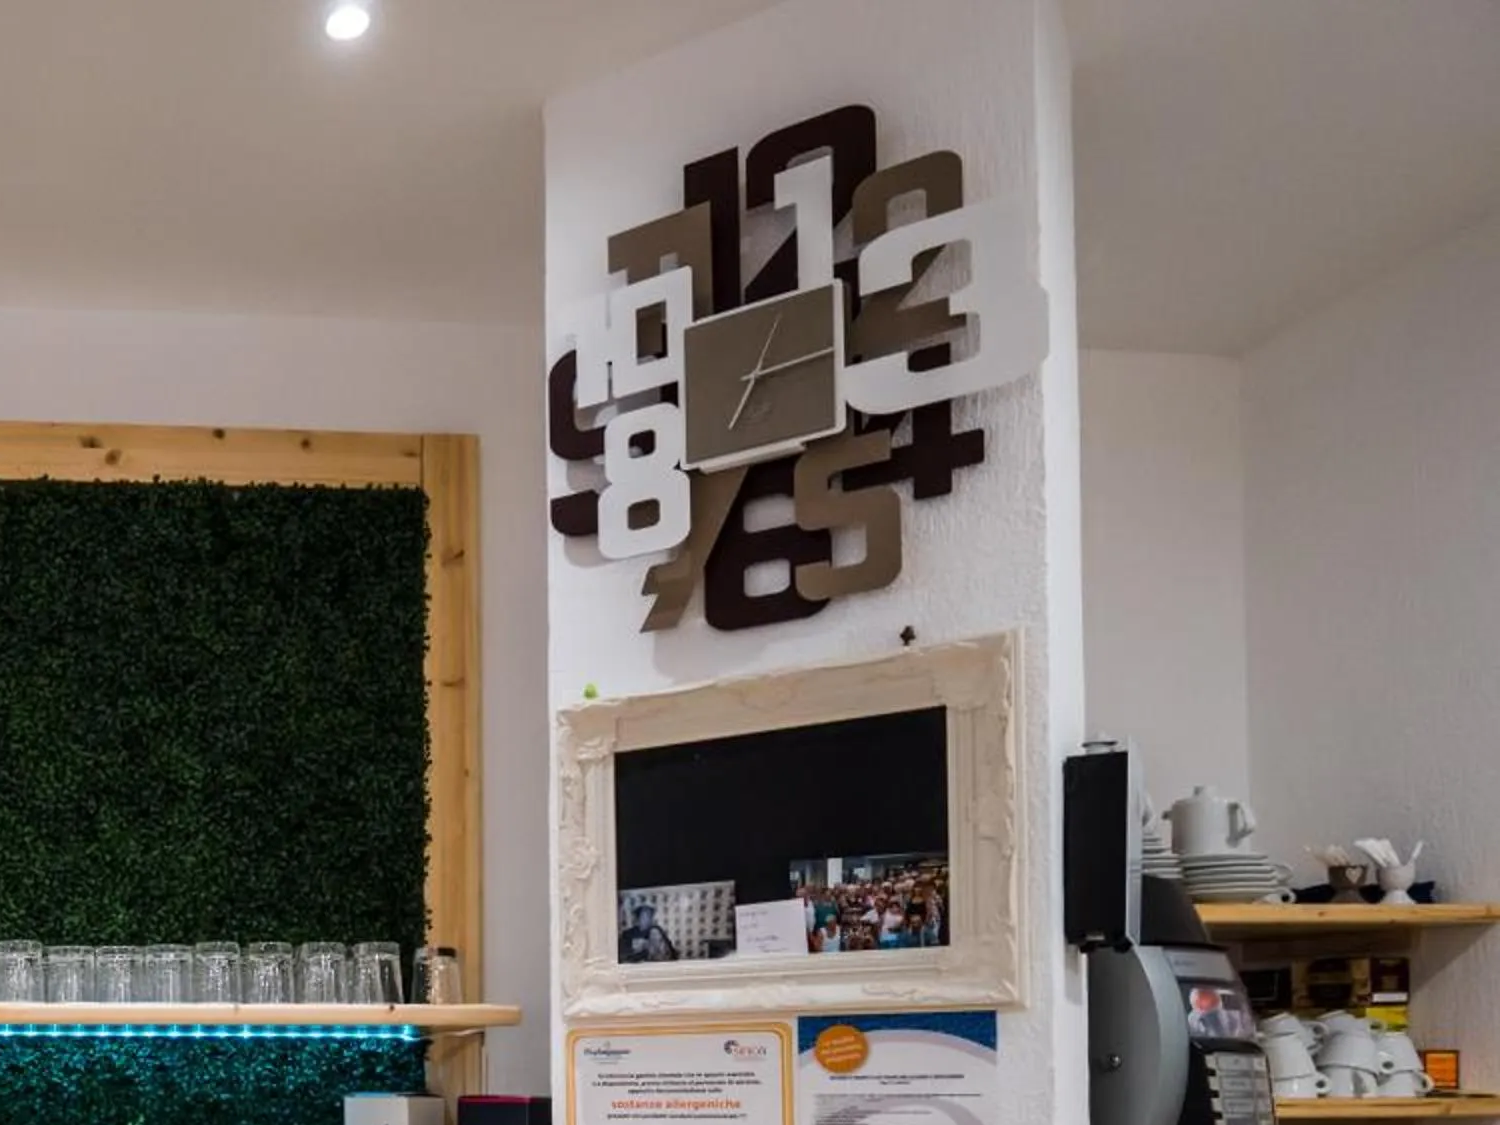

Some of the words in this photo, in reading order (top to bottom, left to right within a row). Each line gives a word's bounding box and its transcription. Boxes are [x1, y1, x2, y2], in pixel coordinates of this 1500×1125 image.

[683, 105, 877, 318] 12
[775, 155, 834, 291] 1
[852, 148, 967, 358] 2
[574, 266, 694, 409] 10
[843, 200, 1050, 415] 3
[598, 402, 691, 559] 8
[845, 342, 985, 501] 4
[703, 455, 833, 632] 6
[793, 425, 903, 602] 5
